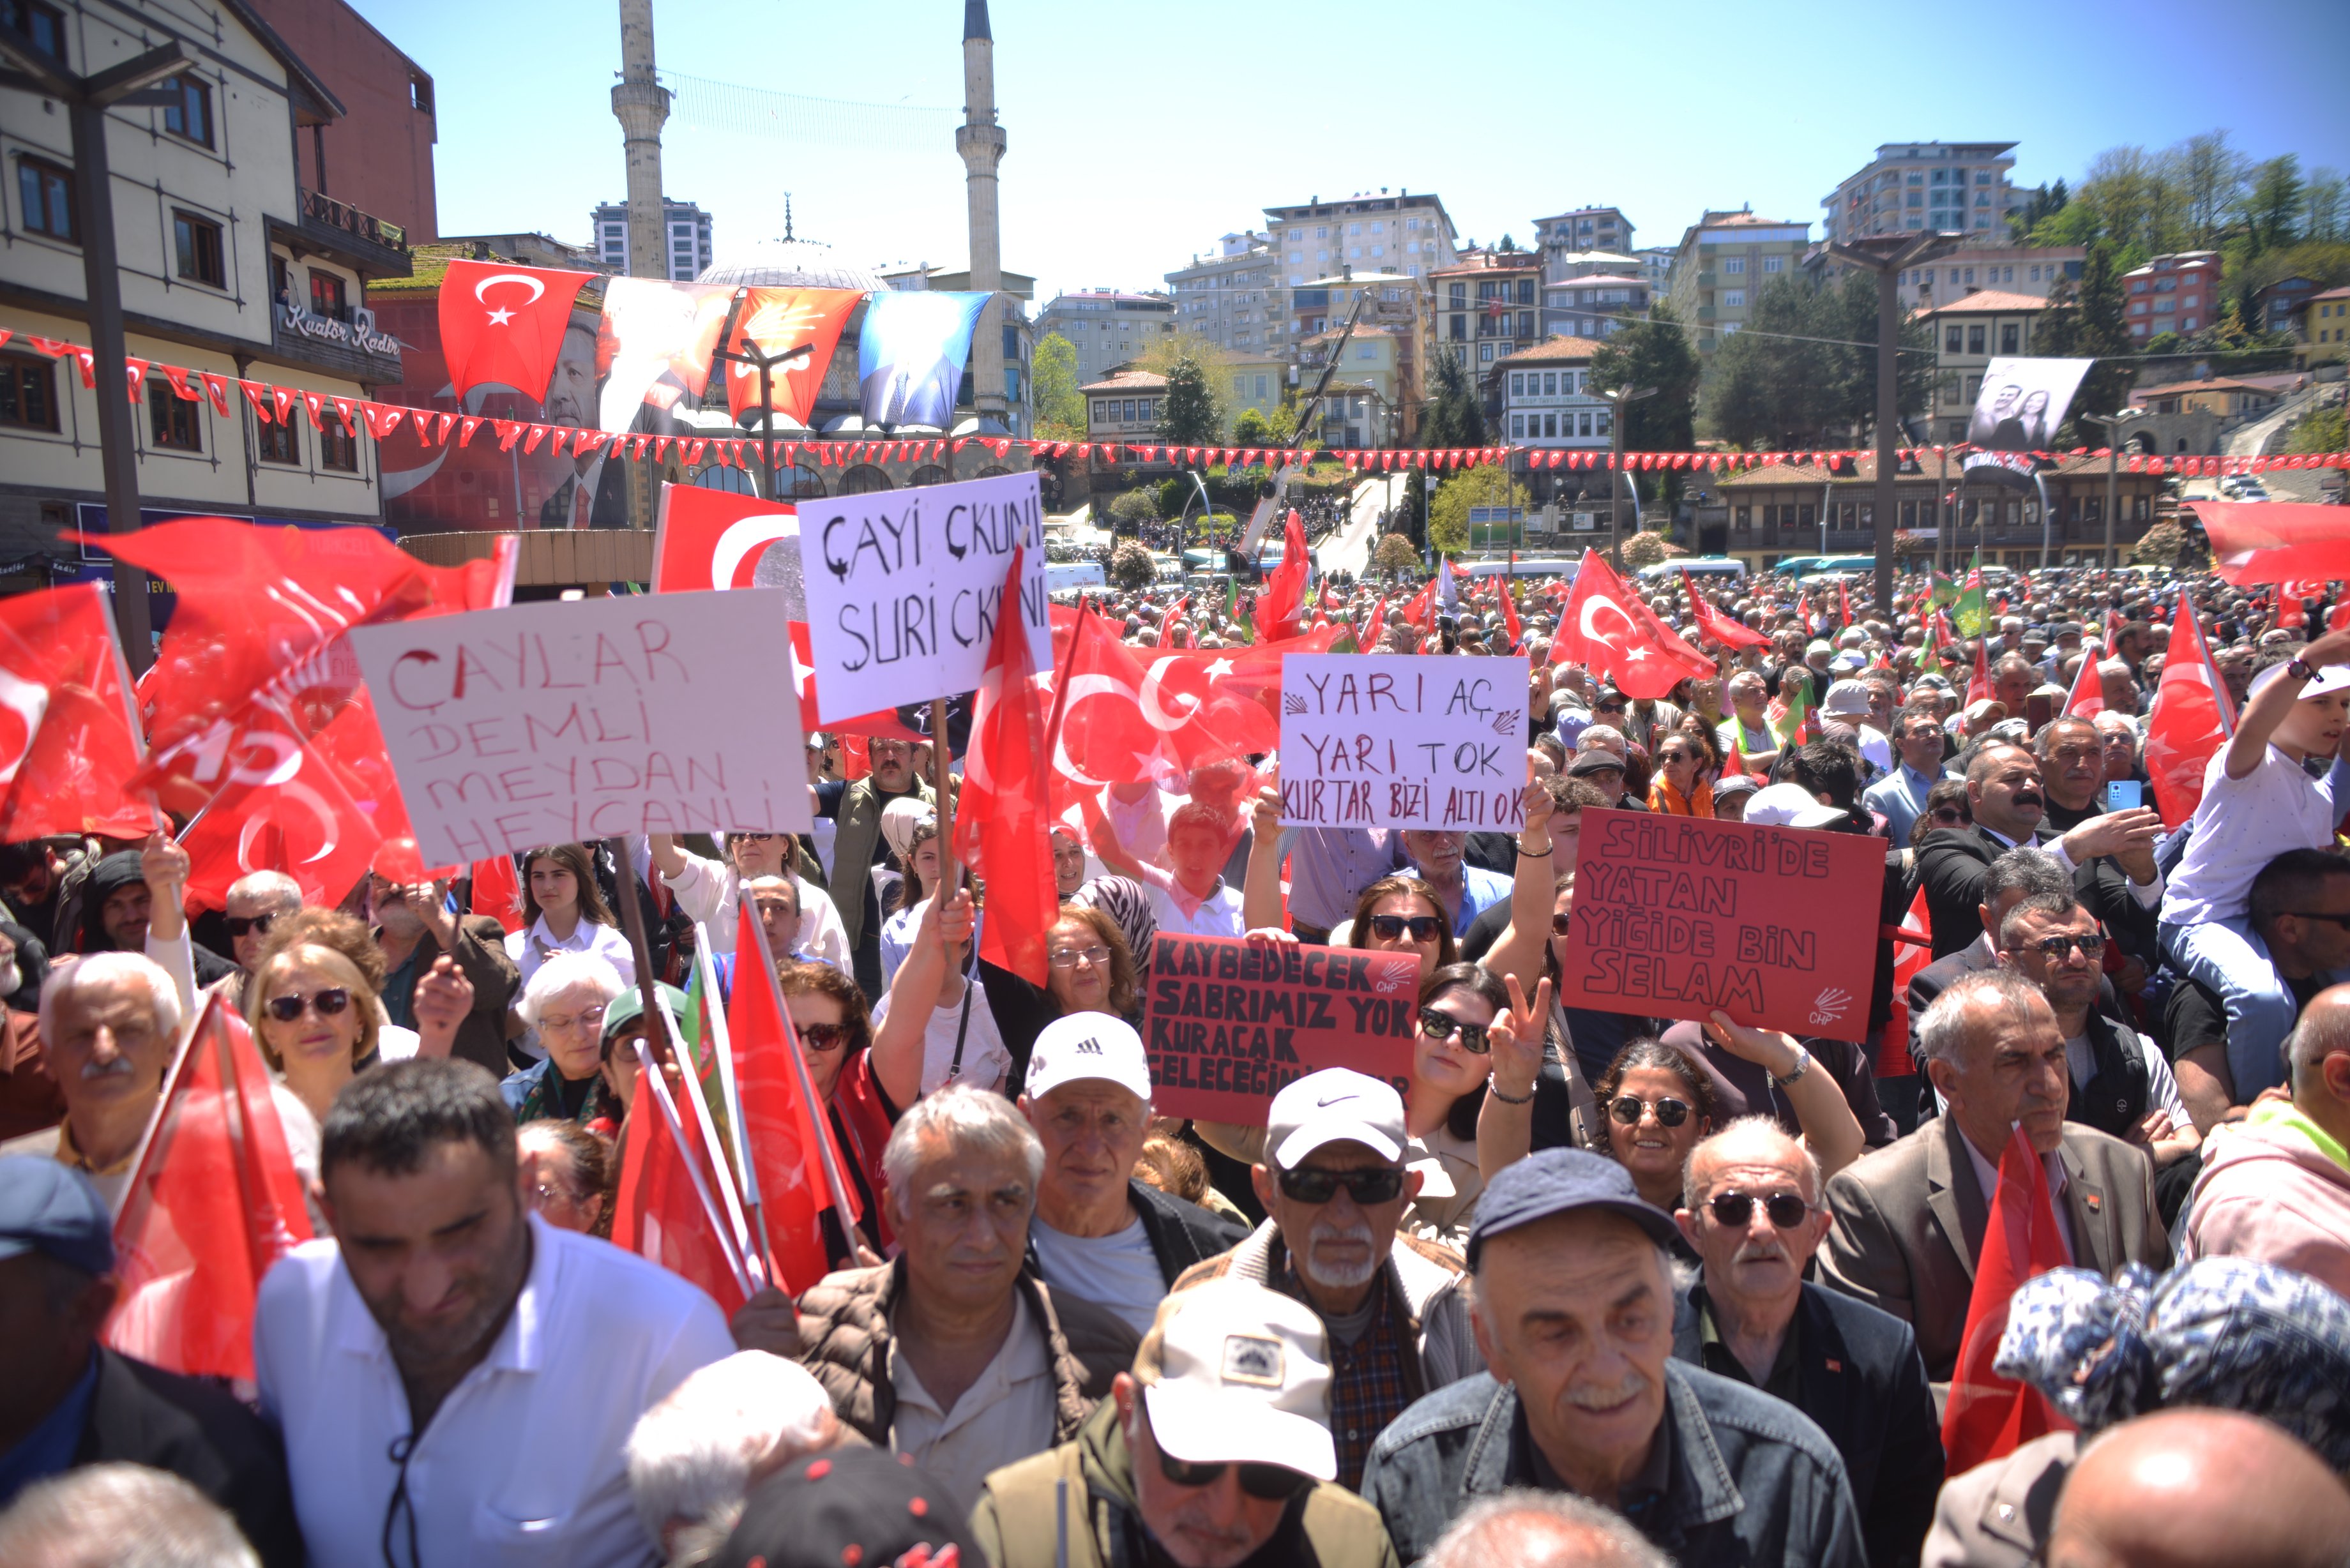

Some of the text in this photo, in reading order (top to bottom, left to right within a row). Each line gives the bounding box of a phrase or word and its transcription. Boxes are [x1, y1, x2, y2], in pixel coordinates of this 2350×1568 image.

[285, 305, 400, 355] Kuaför Kadir
[389, 620, 690, 716] ÇAYLAR
[1306, 672, 1494, 722] YARI AÇ
[407, 688, 651, 763] DEMLİ
[426, 751, 727, 810] MEYDAN
[1301, 734, 1505, 778] YARI TOK
[1282, 776, 1526, 829] KURTAR BİZİ ALTI OK
[1601, 818, 1830, 878] SİLİVRİ'DE
[1582, 860, 1738, 917] YATAN
[1154, 938, 1372, 992] KAYBEDECEK
[1577, 903, 1816, 972] YİĞİDE BİN
[1153, 979, 1414, 1039] SABRIMIZ YOK
[1376, 981, 1398, 993] CHP
[1583, 949, 1764, 1014] SELAM
[1150, 1016, 1300, 1064] KURACAK
[1808, 1011, 1833, 1025] CHP
